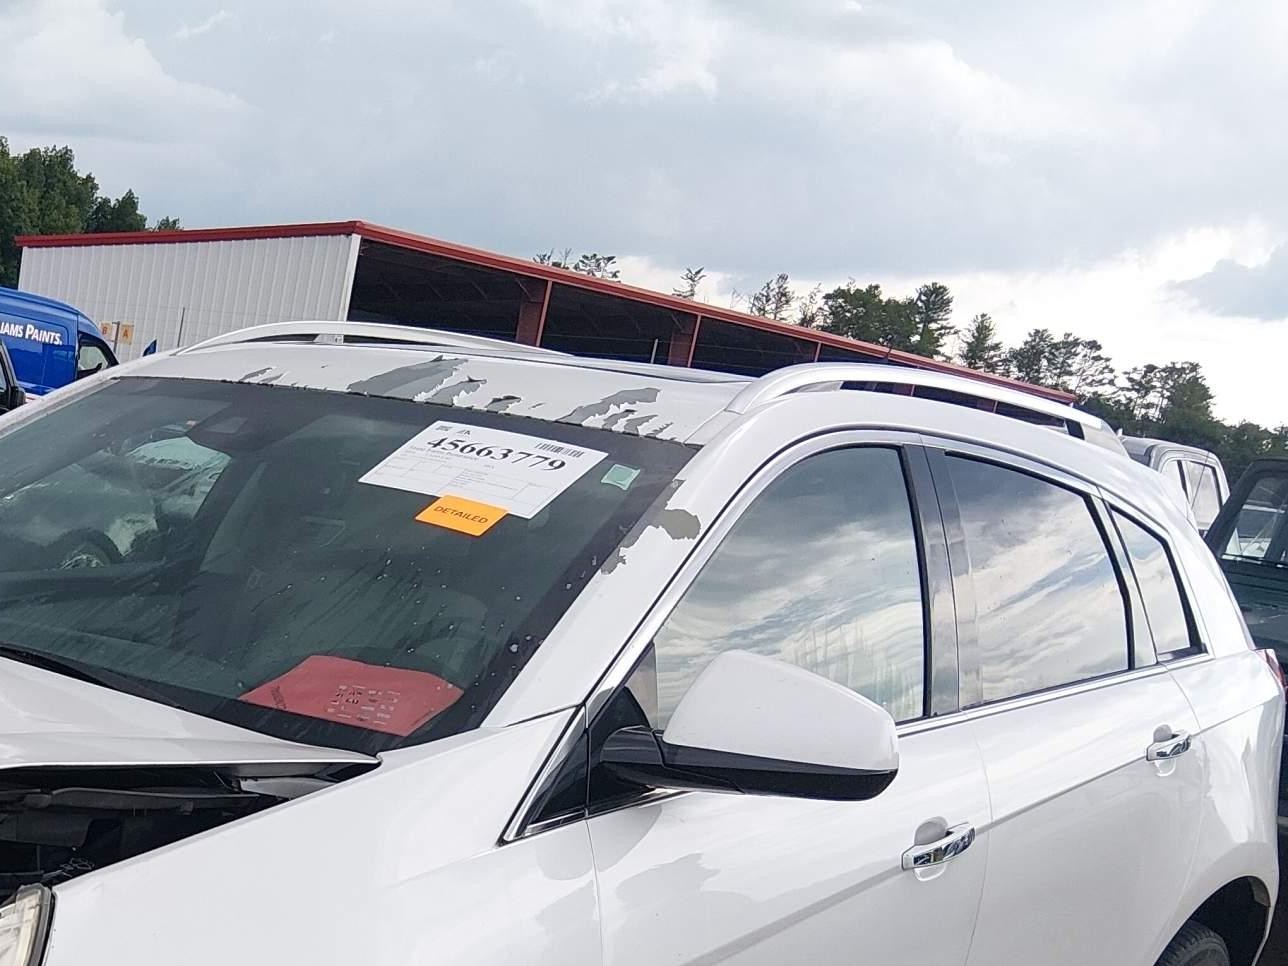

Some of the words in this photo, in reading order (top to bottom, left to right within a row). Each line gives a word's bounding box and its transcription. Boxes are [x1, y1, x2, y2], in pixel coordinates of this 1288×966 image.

[25, 324, 63, 345] PAINTS.
[427, 437, 566, 472] 45663779
[434, 505, 488, 525] DETAILED
